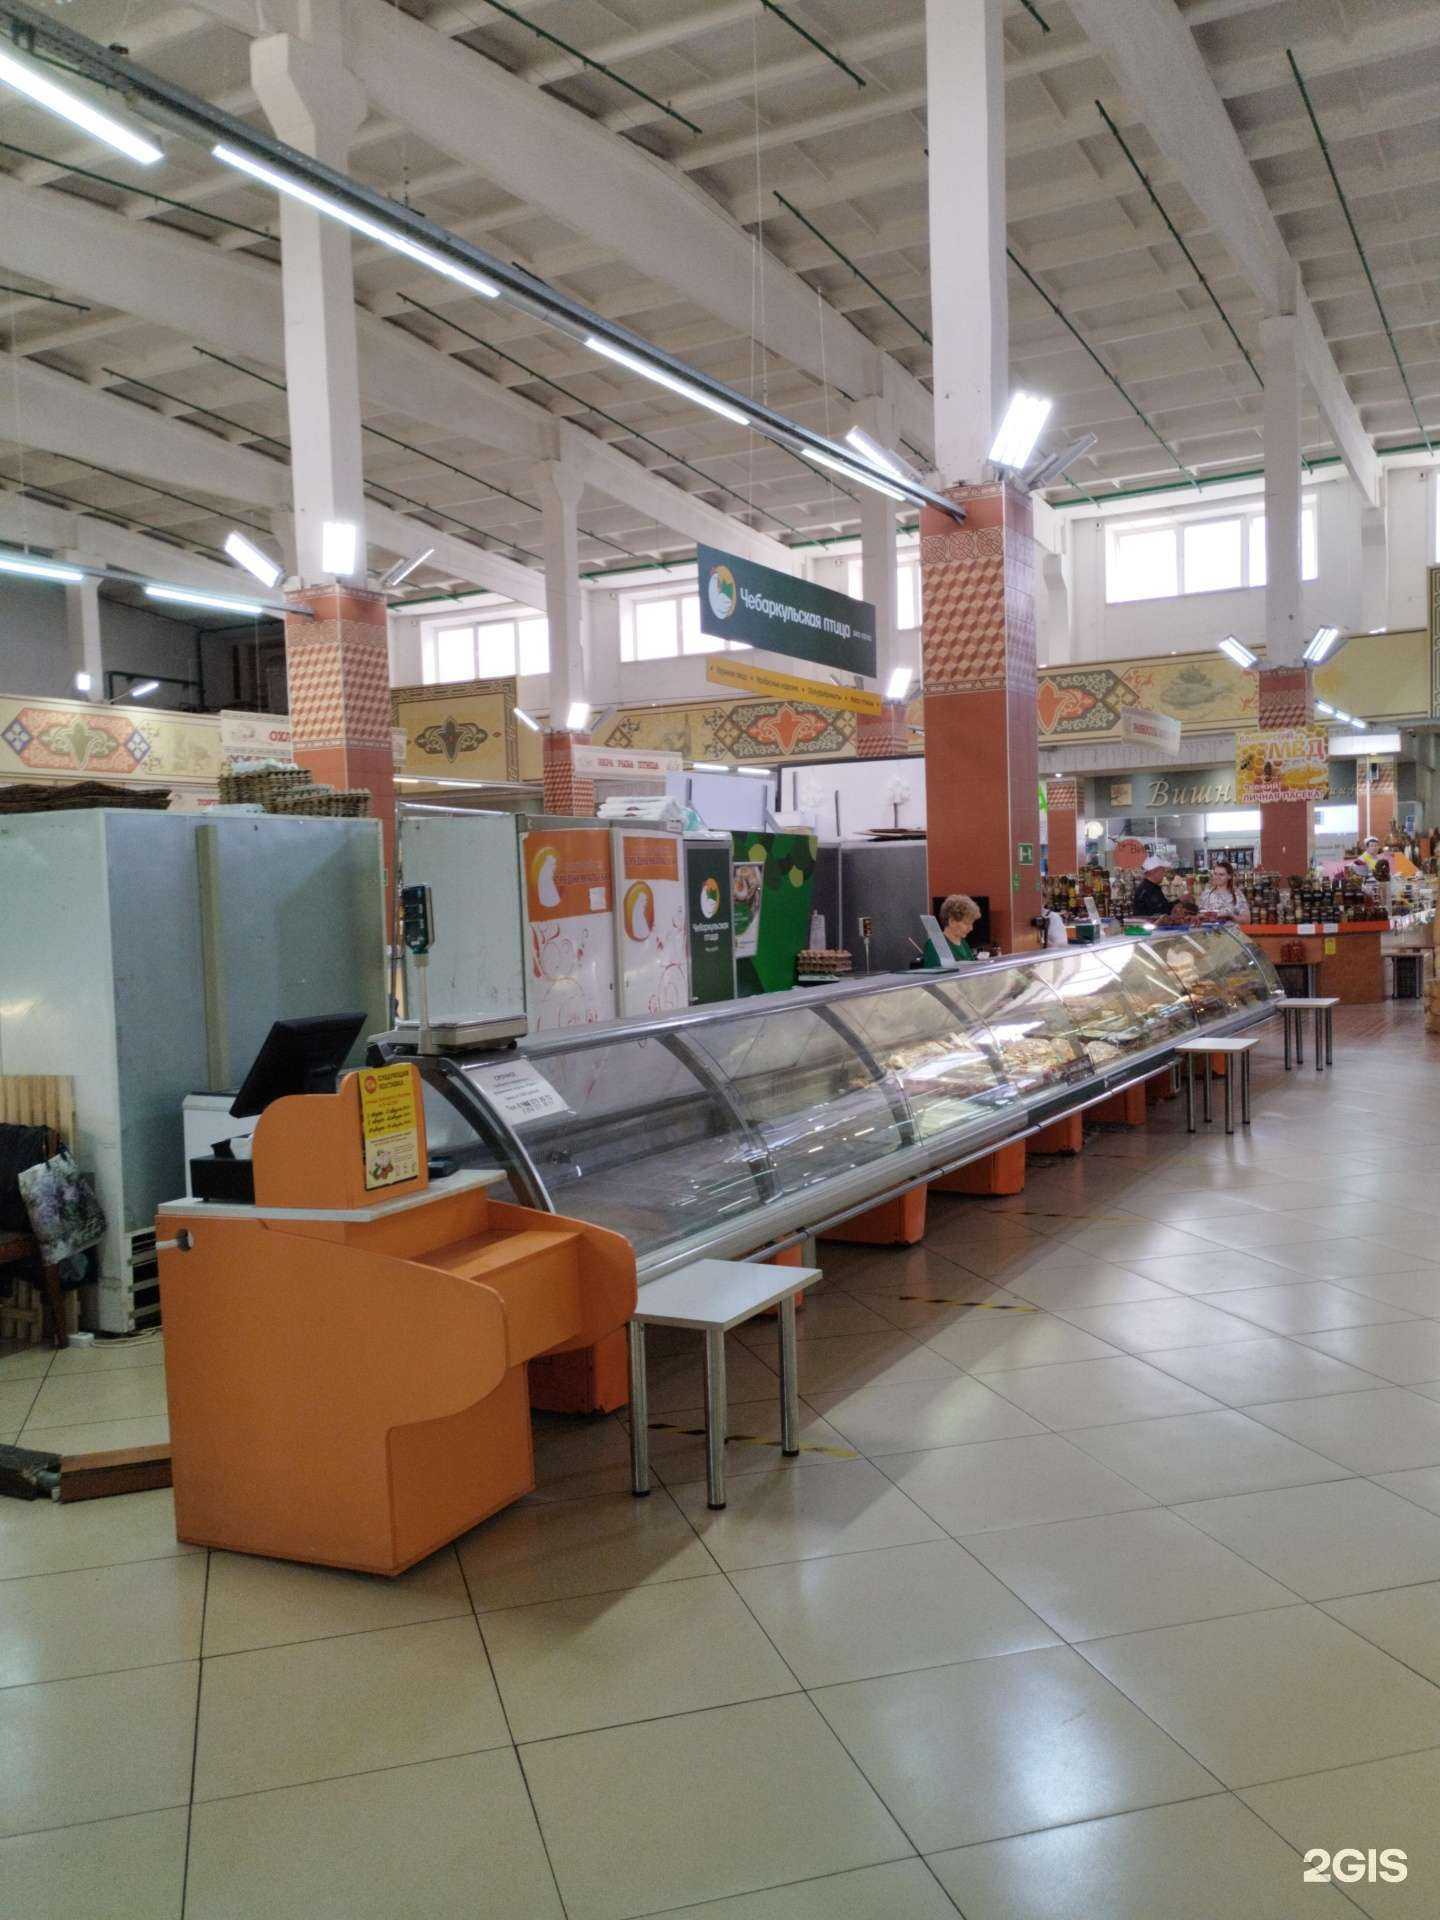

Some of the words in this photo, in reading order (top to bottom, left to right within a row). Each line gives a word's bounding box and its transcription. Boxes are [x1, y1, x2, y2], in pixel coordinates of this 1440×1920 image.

[739, 587, 822, 629] Чебаркульская
[823, 616, 851, 639] птица
[1143, 777, 1236, 808] Вишн
[1243, 790, 1280, 801] ЛИЧНАЯ
